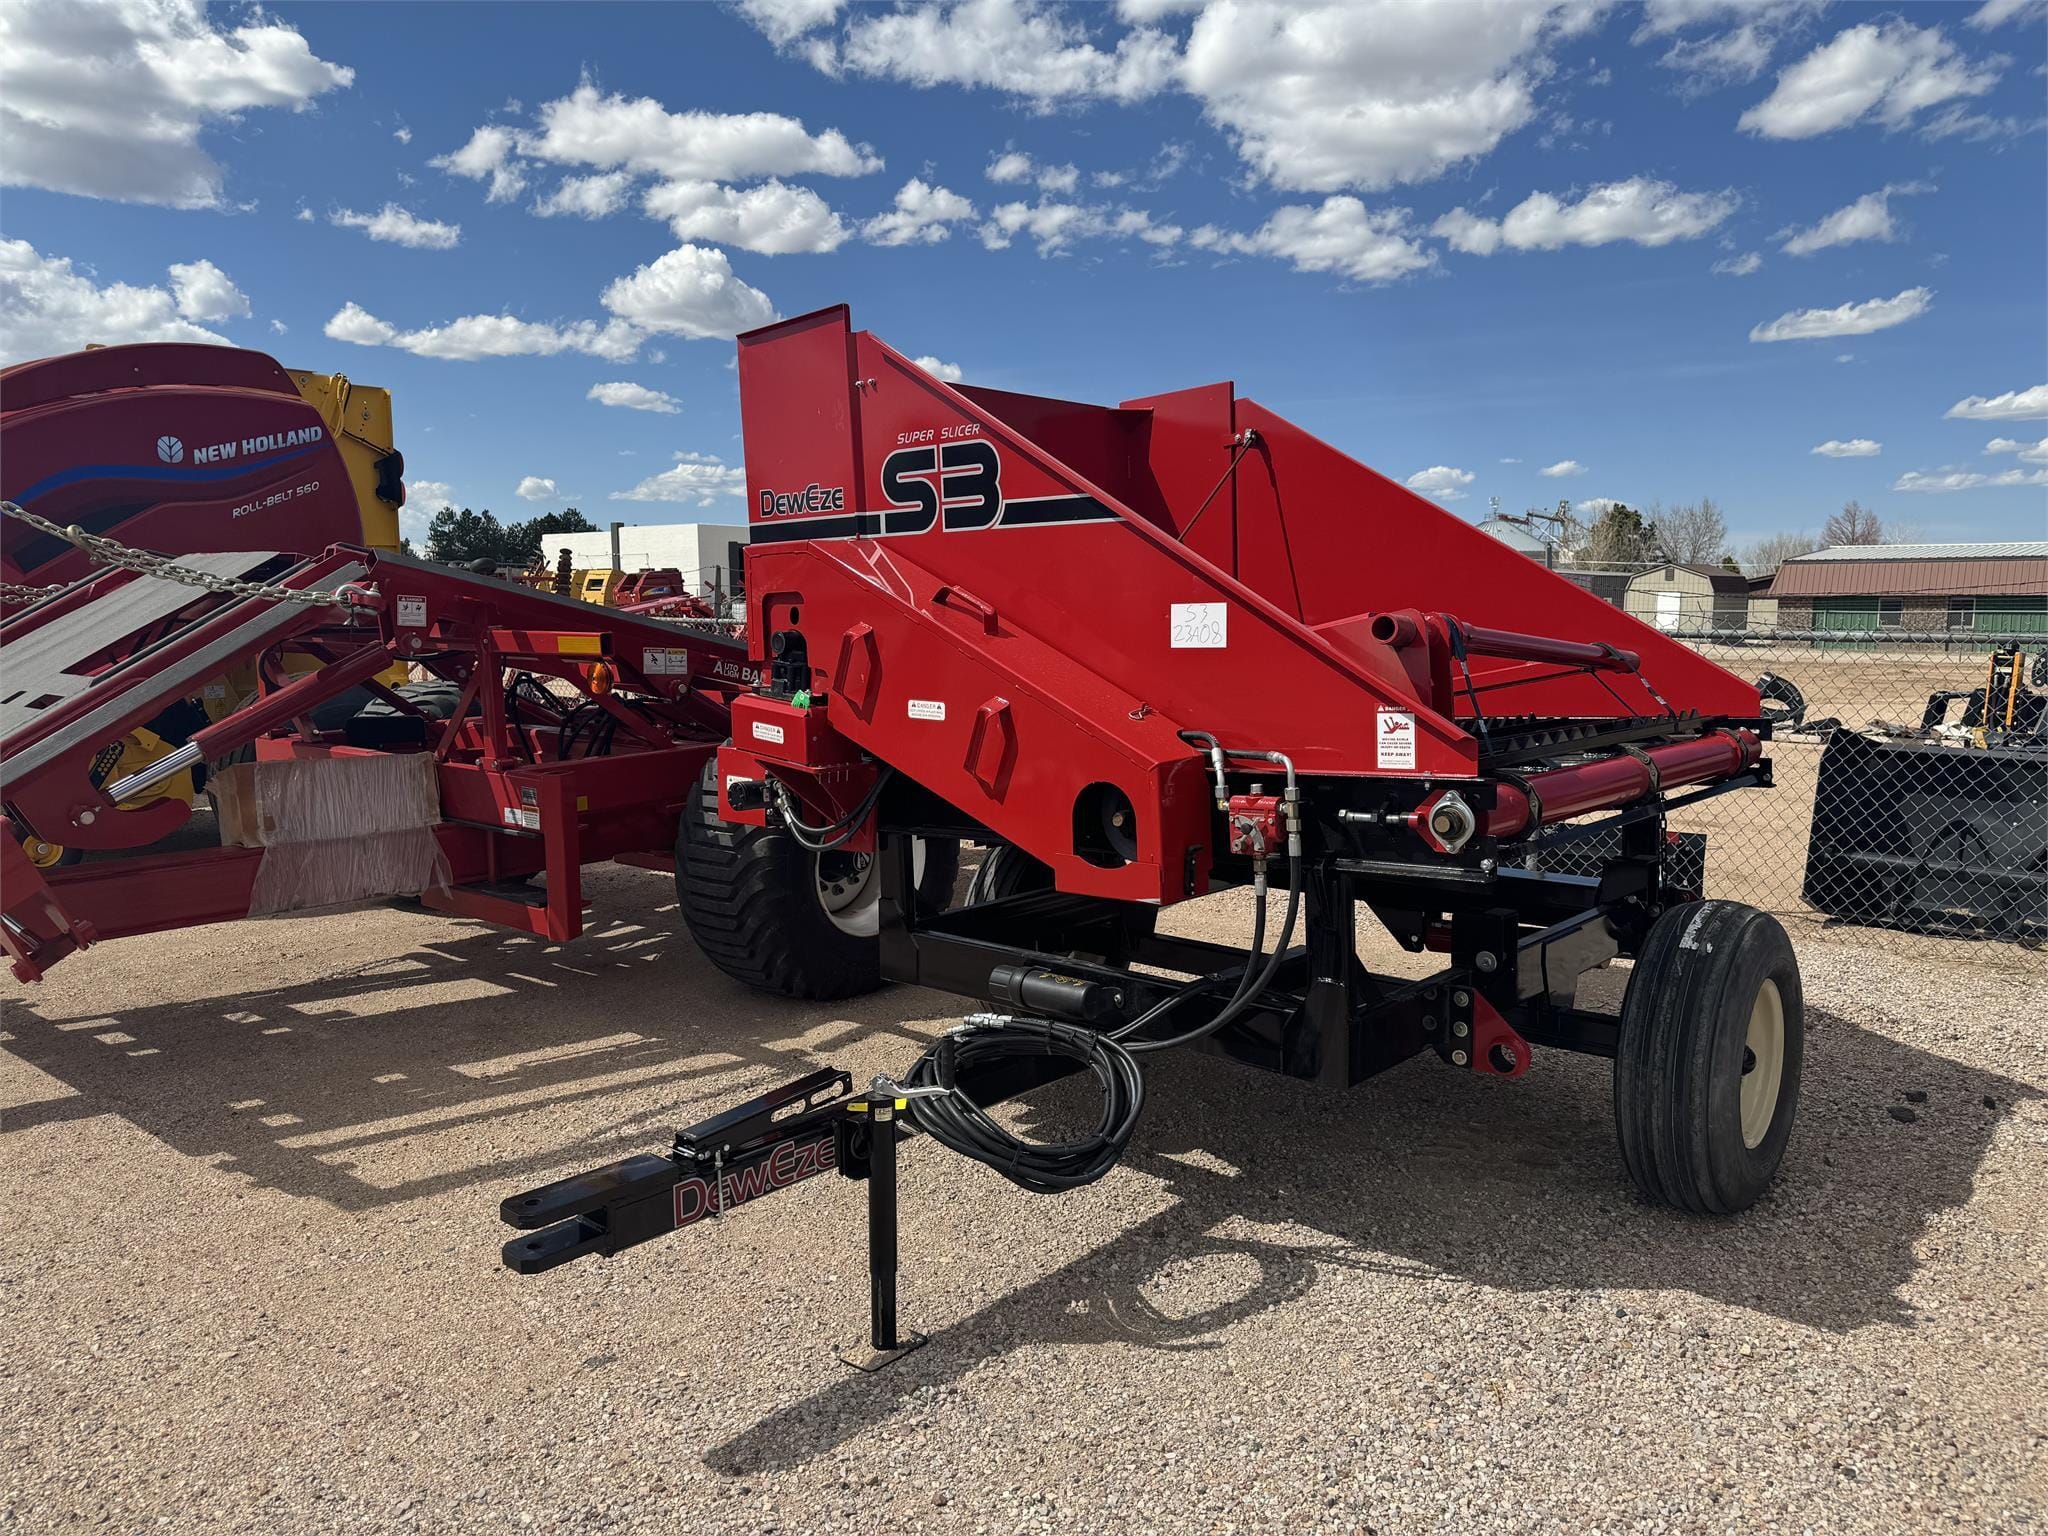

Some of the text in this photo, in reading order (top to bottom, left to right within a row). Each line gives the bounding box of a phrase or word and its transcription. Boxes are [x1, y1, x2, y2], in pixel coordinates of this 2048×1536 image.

[193, 426, 323, 465] NEW HOLLAND
[897, 423, 981, 445] SUPER SLICER
[232, 481, 320, 518] ROLL-BELT 560
